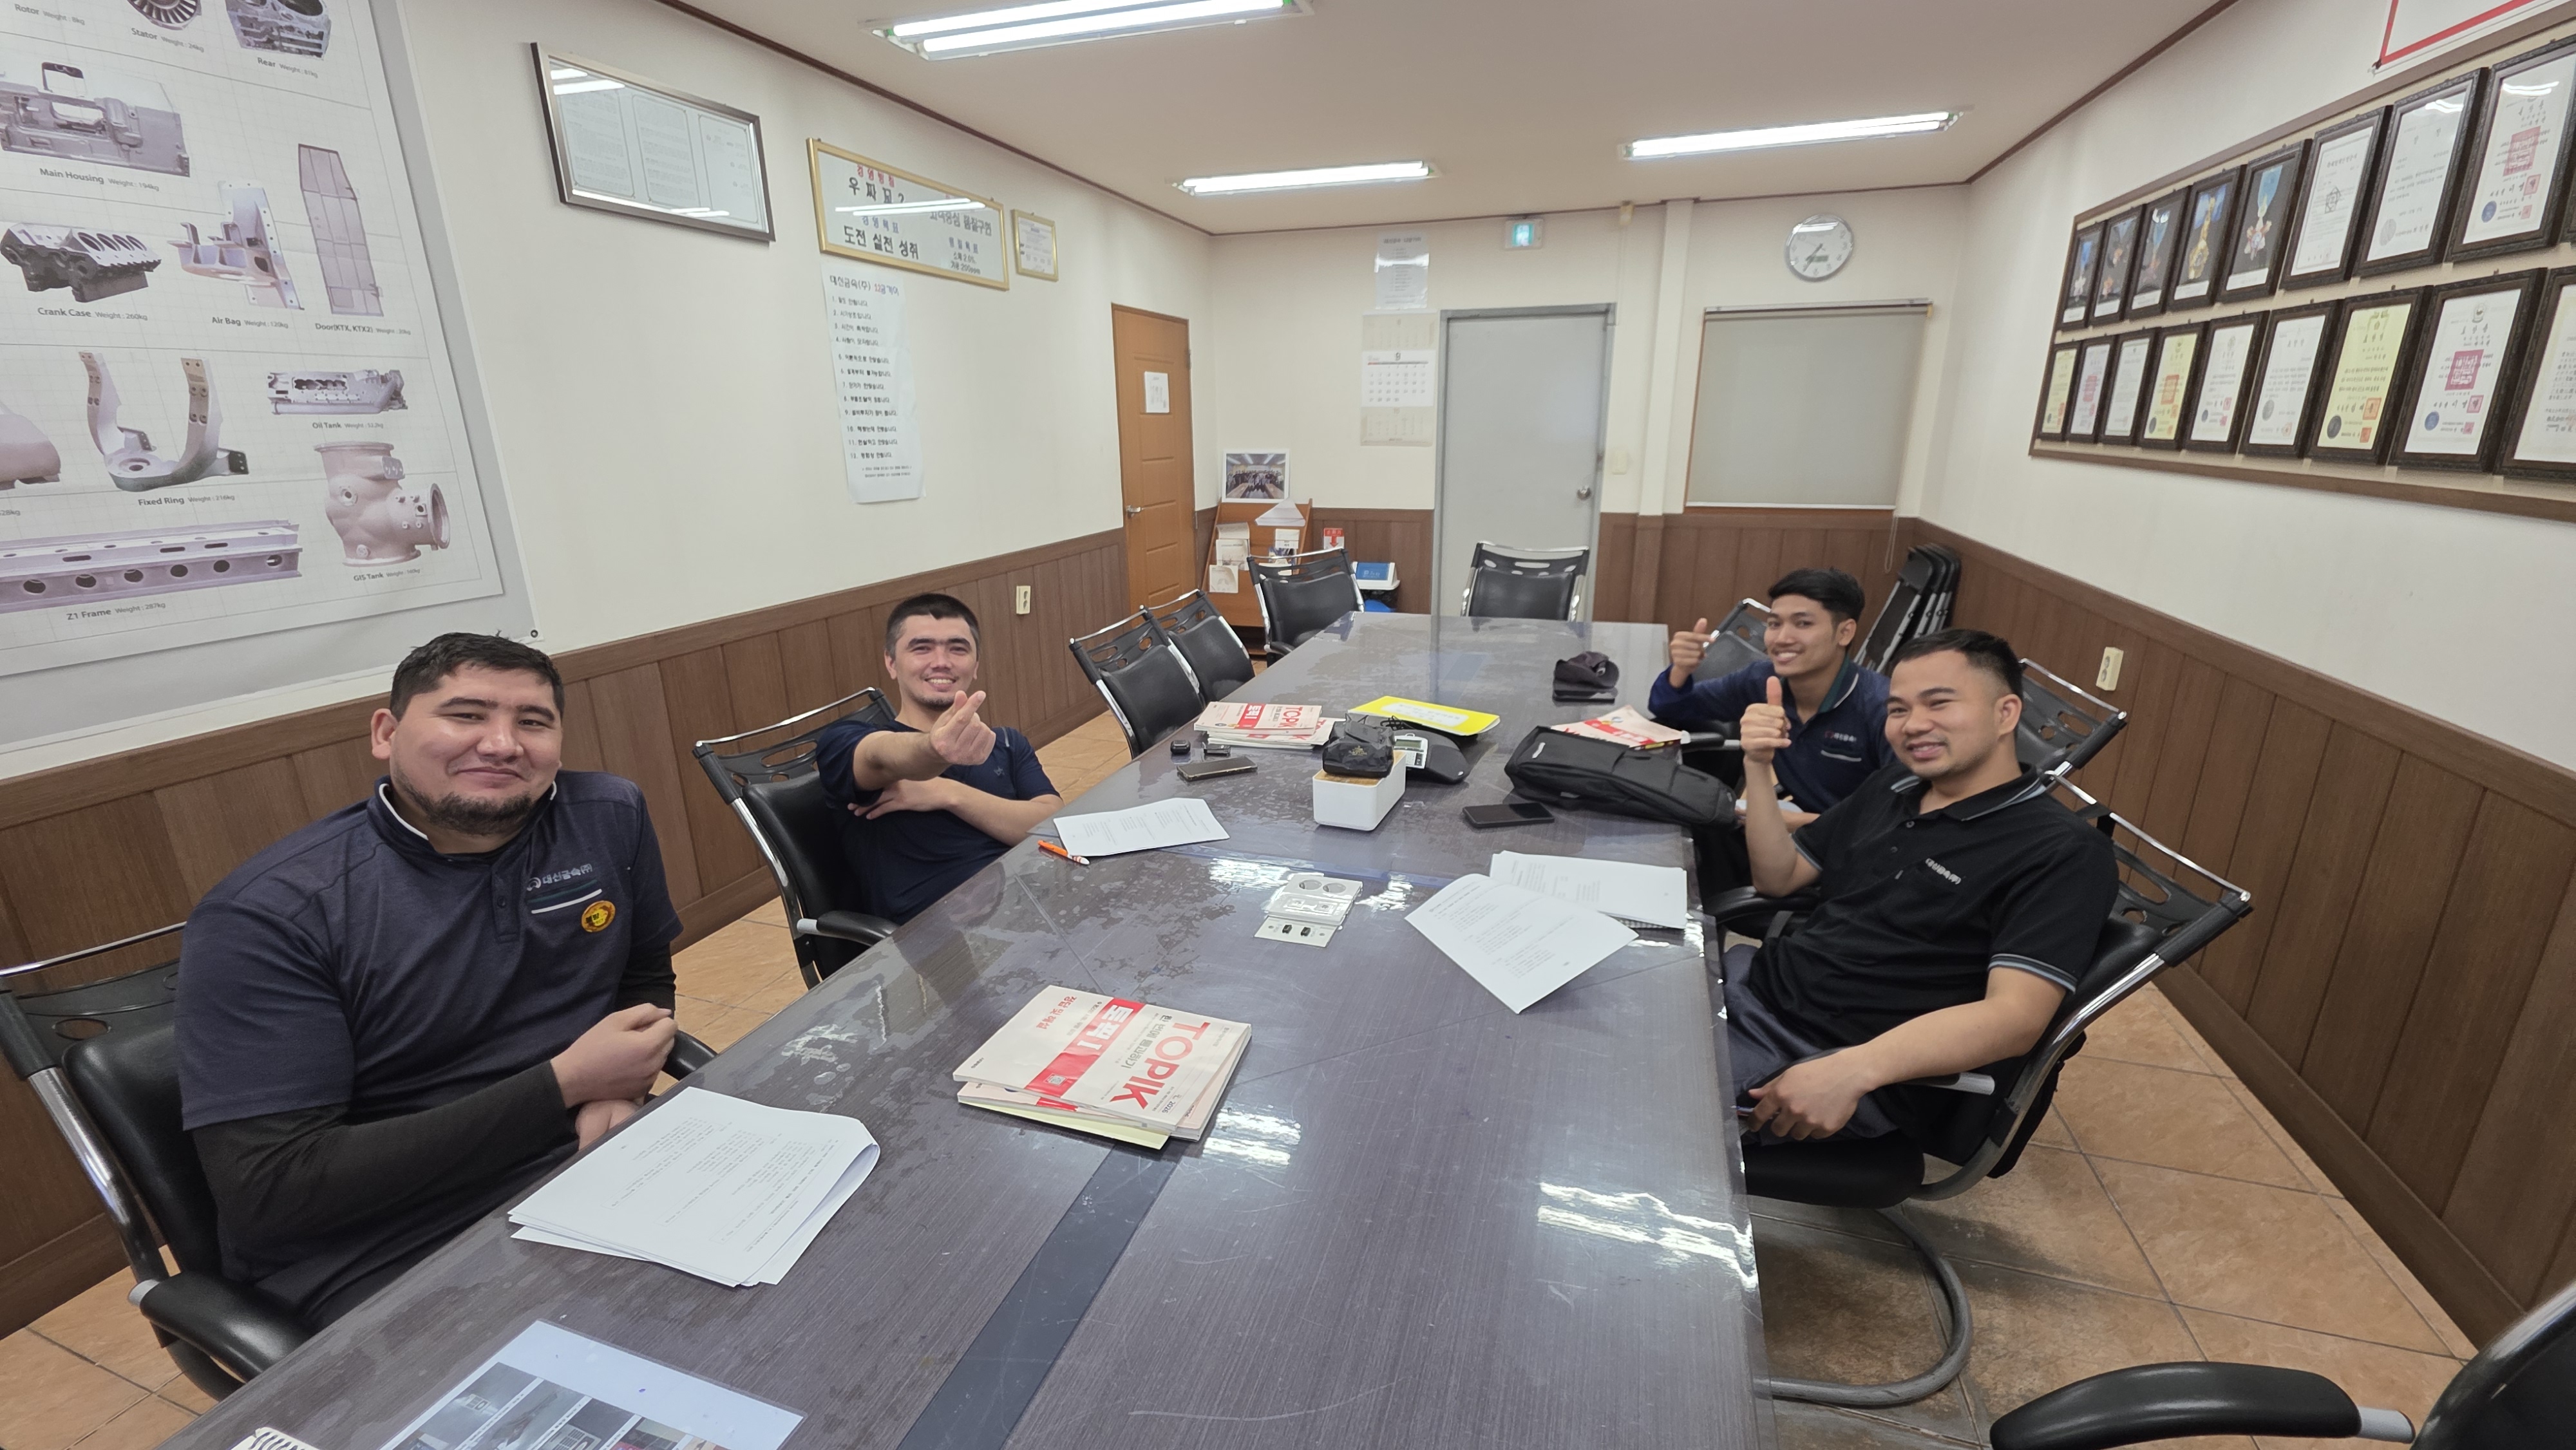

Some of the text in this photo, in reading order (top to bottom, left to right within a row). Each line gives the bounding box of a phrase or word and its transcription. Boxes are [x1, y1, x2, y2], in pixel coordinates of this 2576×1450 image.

[15, 4, 39, 15] Rotor
[131, 28, 157, 40] Stator
[258, 57, 276, 67] Rear
[39, 168, 64, 178] Main
[65, 171, 104, 184] Housing
[108, 178, 133, 187] Weight
[844, 225, 918, 259] 도전 실전 성취
[37, 307, 67, 316] Crank
[225, 317, 242, 326] Bag
[138, 498, 162, 506] Fixed
[164, 496, 185, 505] Ring
[188, 496, 211, 504] Weight
[81, 610, 111, 618] Frame
[1036, 995, 1077, 1030] 정답 및 해설
[1086, 1004, 1134, 1040] 토픽
[1159, 1015, 1173, 1023] 한
[1146, 1023, 1166, 1039] 번에
[1110, 1022, 1211, 1109] TOPIK
[1162, 1101, 1177, 1113] 2026
